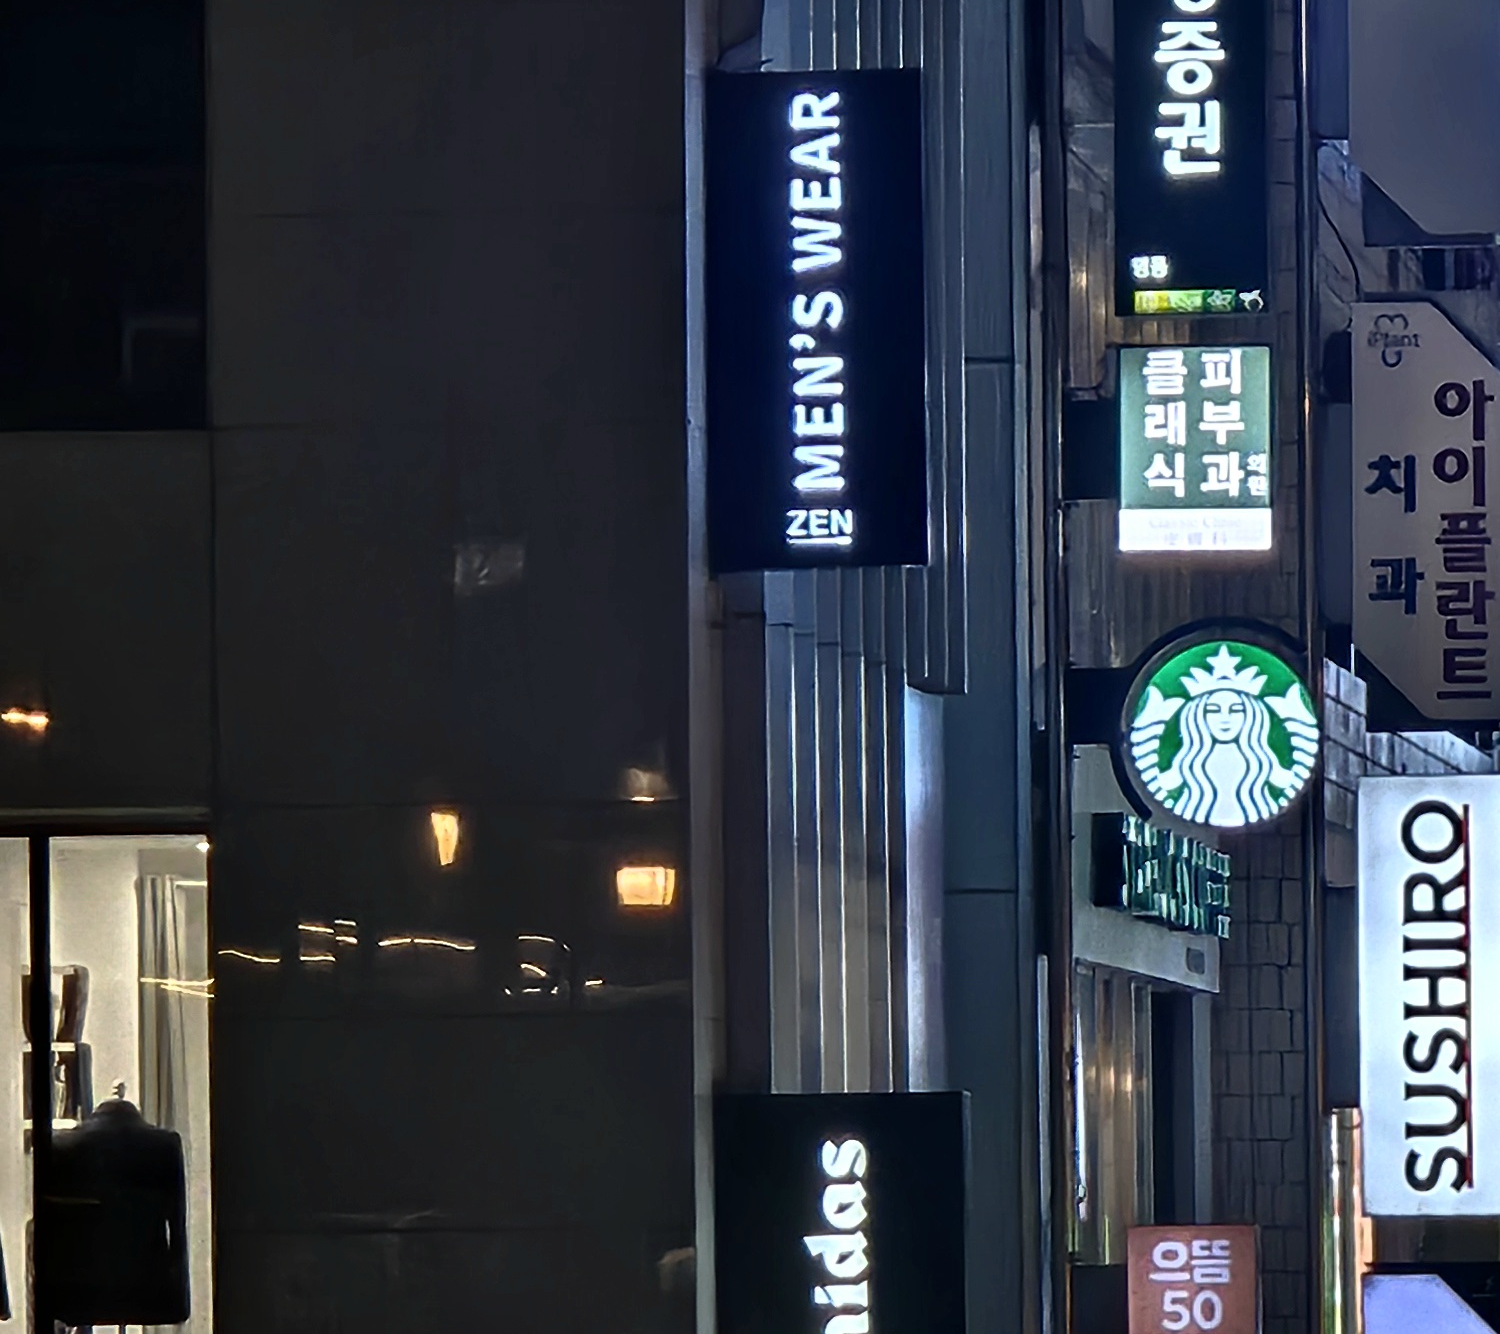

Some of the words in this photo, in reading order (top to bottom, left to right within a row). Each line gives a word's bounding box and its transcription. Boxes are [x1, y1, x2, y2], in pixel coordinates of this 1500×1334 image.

[789, 91, 844, 271] WEAR
[789, 290, 845, 493] MEN'S
[1143, 350, 1187, 497] 클래식
[1199, 350, 1245, 496] 피부과
[785, 509, 853, 536] ZEN
[1364, 454, 1424, 615] 치과
[1432, 379, 1495, 699] 아이플란트
[1401, 800, 1468, 1193] SUSHIRO
[1149, 1239, 1230, 1284] 으뜸
[1161, 1290, 1222, 1331] 50
